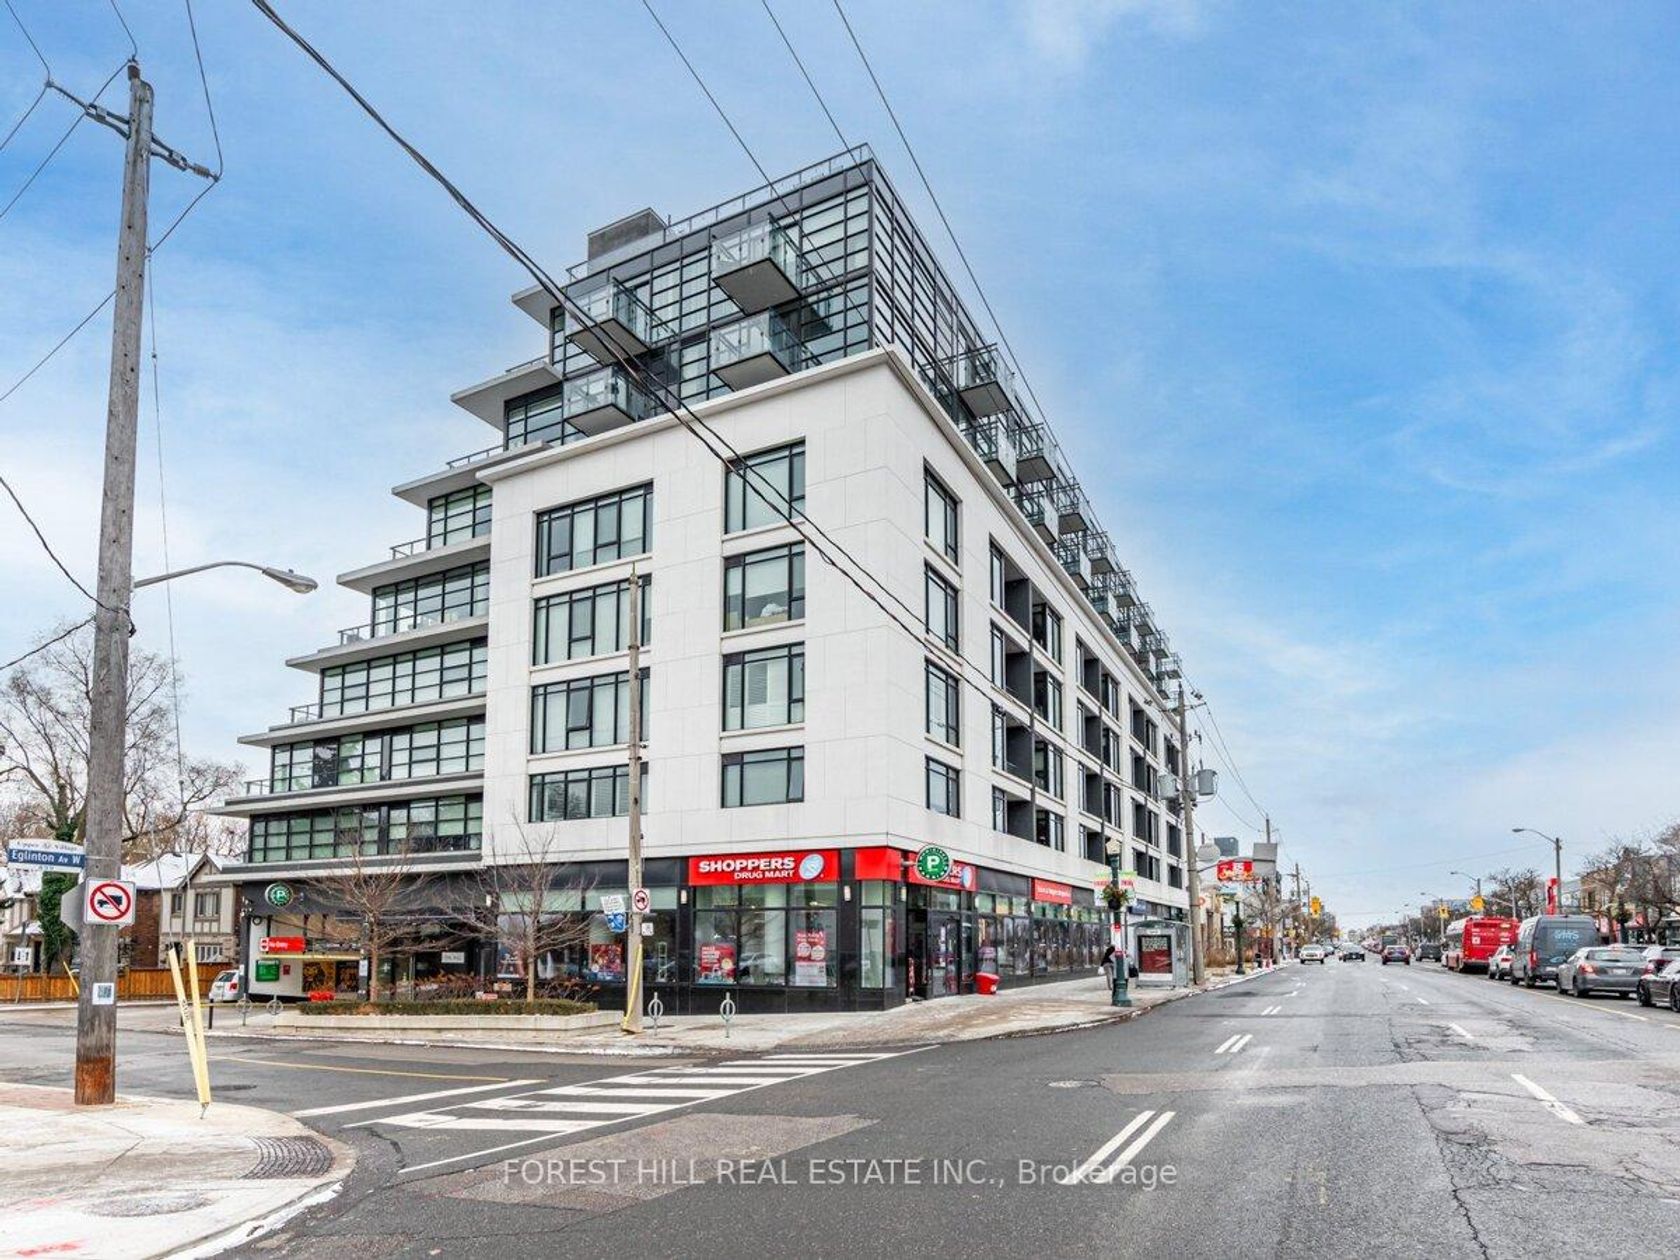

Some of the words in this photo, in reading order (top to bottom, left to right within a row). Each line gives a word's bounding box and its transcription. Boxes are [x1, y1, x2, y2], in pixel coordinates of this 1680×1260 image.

[12, 850, 55, 862] Eglinton
[72, 855, 81, 864] W
[926, 855, 940, 870] P
[699, 857, 795, 873] SHOPPERS
[734, 871, 763, 880] DRUG
[764, 870, 795, 878] MART
